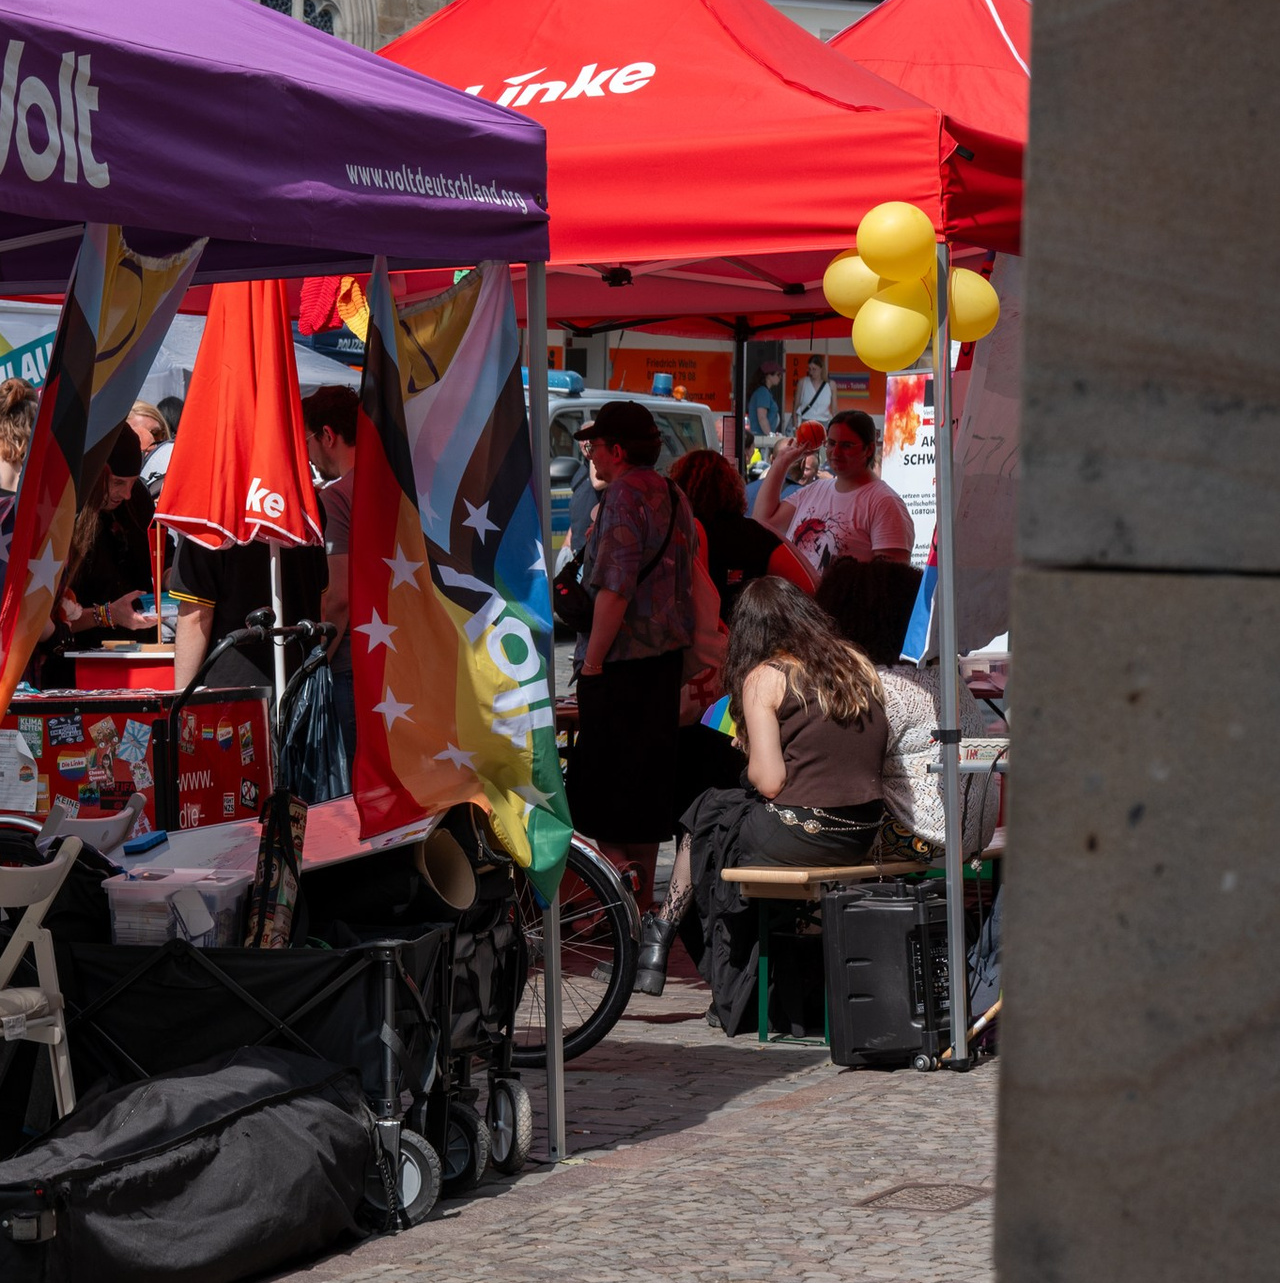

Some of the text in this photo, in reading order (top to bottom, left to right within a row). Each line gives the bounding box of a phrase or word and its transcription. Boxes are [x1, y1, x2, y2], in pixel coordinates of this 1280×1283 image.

[464, 61, 656, 108] inke
[346, 164, 528, 215] www.voltdeutschland.org
[647, 358, 677, 368] Friedrich
[19, 724, 43, 732] RETTEN
[20, 717, 42, 726] KLIMA
[61, 758, 85, 769] Die Linke
[179, 769, 214, 792] www.
[55, 793, 80, 810] KEINE
[179, 803, 206, 829] die-
